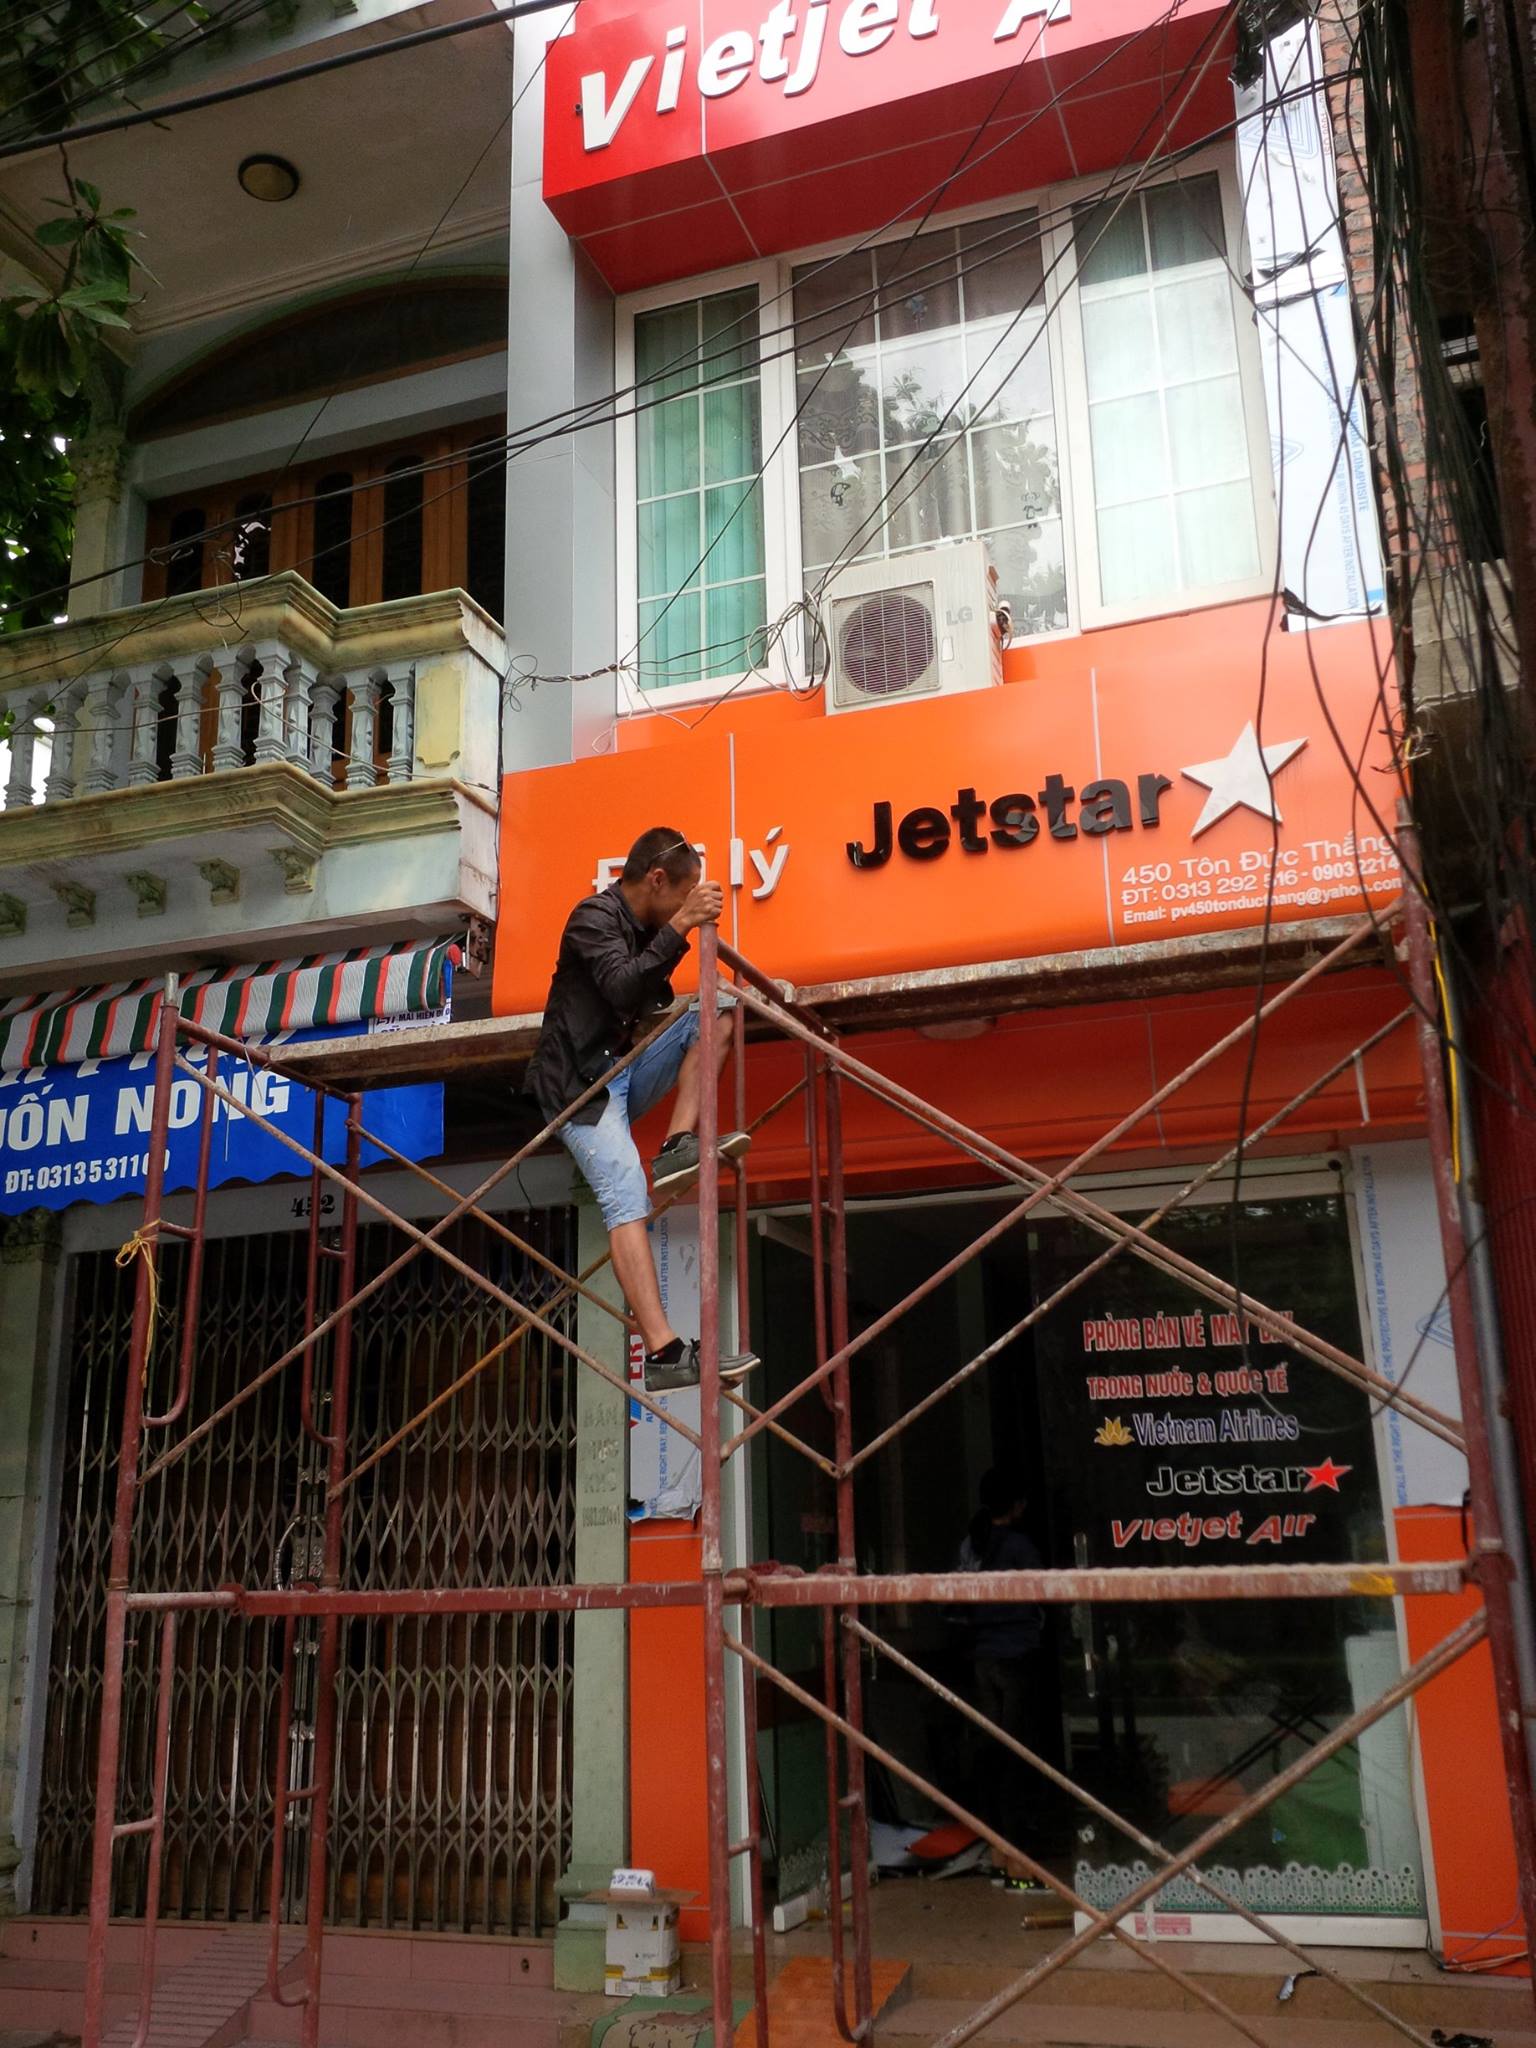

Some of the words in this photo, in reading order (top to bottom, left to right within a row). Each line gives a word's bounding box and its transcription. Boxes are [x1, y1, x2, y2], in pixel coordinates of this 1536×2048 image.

[579, 0, 940, 152] Vietjet
[1352, 450, 1370, 513] COMPOSITE
[946, 606, 973, 627] LG
[729, 825, 790, 900] lý
[846, 773, 1174, 869] Jetstar
[1121, 864, 1172, 885] 450
[1179, 857, 1231, 879] Tôn
[1216, 875, 1257, 893] 292
[1123, 907, 1166, 925] Email:
[1083, 1311, 1142, 1352] PHÒNG
[1143, 1310, 1180, 1350] BÁN
[1086, 1375, 1143, 1400] TRONG
[1197, 1371, 1212, 1397] &
[1133, 1411, 1217, 1446] Vietnam
[1219, 1408, 1300, 1443] Airlines
[1146, 1464, 1306, 1497] Jetstar
[1112, 1511, 1244, 1549] Vietjet
[1246, 1513, 1317, 1545] Air
